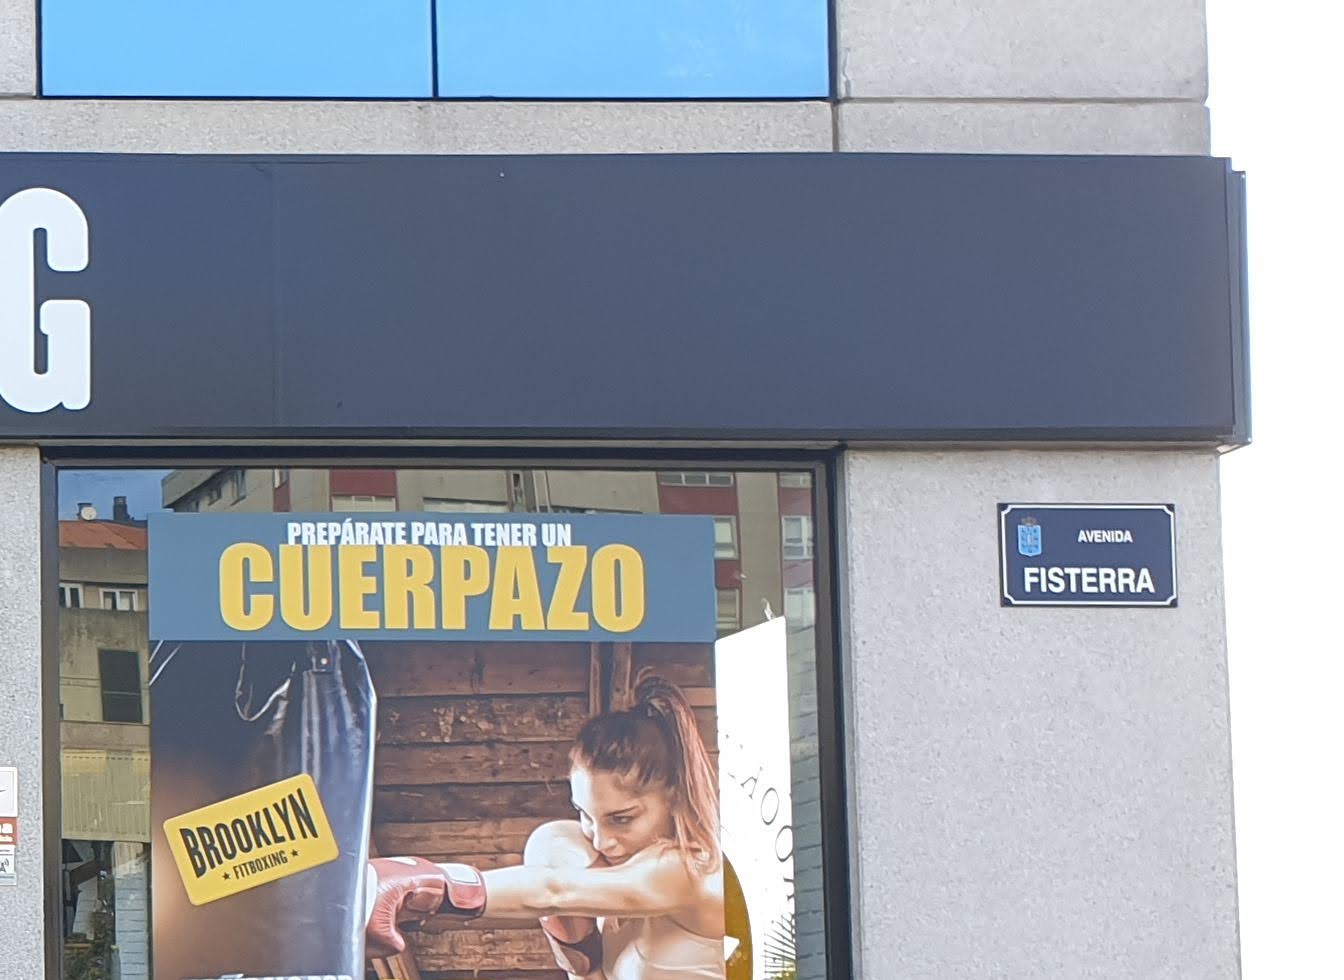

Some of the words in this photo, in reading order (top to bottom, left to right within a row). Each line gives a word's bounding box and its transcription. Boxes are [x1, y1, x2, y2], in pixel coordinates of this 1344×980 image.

[287, 518, 406, 546] PREPÁRATE
[411, 521, 467, 546] PARA
[471, 522, 538, 547] TENER
[541, 522, 572, 547] UN
[1077, 529, 1134, 544] AVENIDA
[218, 543, 646, 633] CUERPAZO
[1023, 566, 1156, 594] FISTERRA
[179, 787, 320, 879] BROOKLYN
[232, 849, 289, 880] FITBOXING
